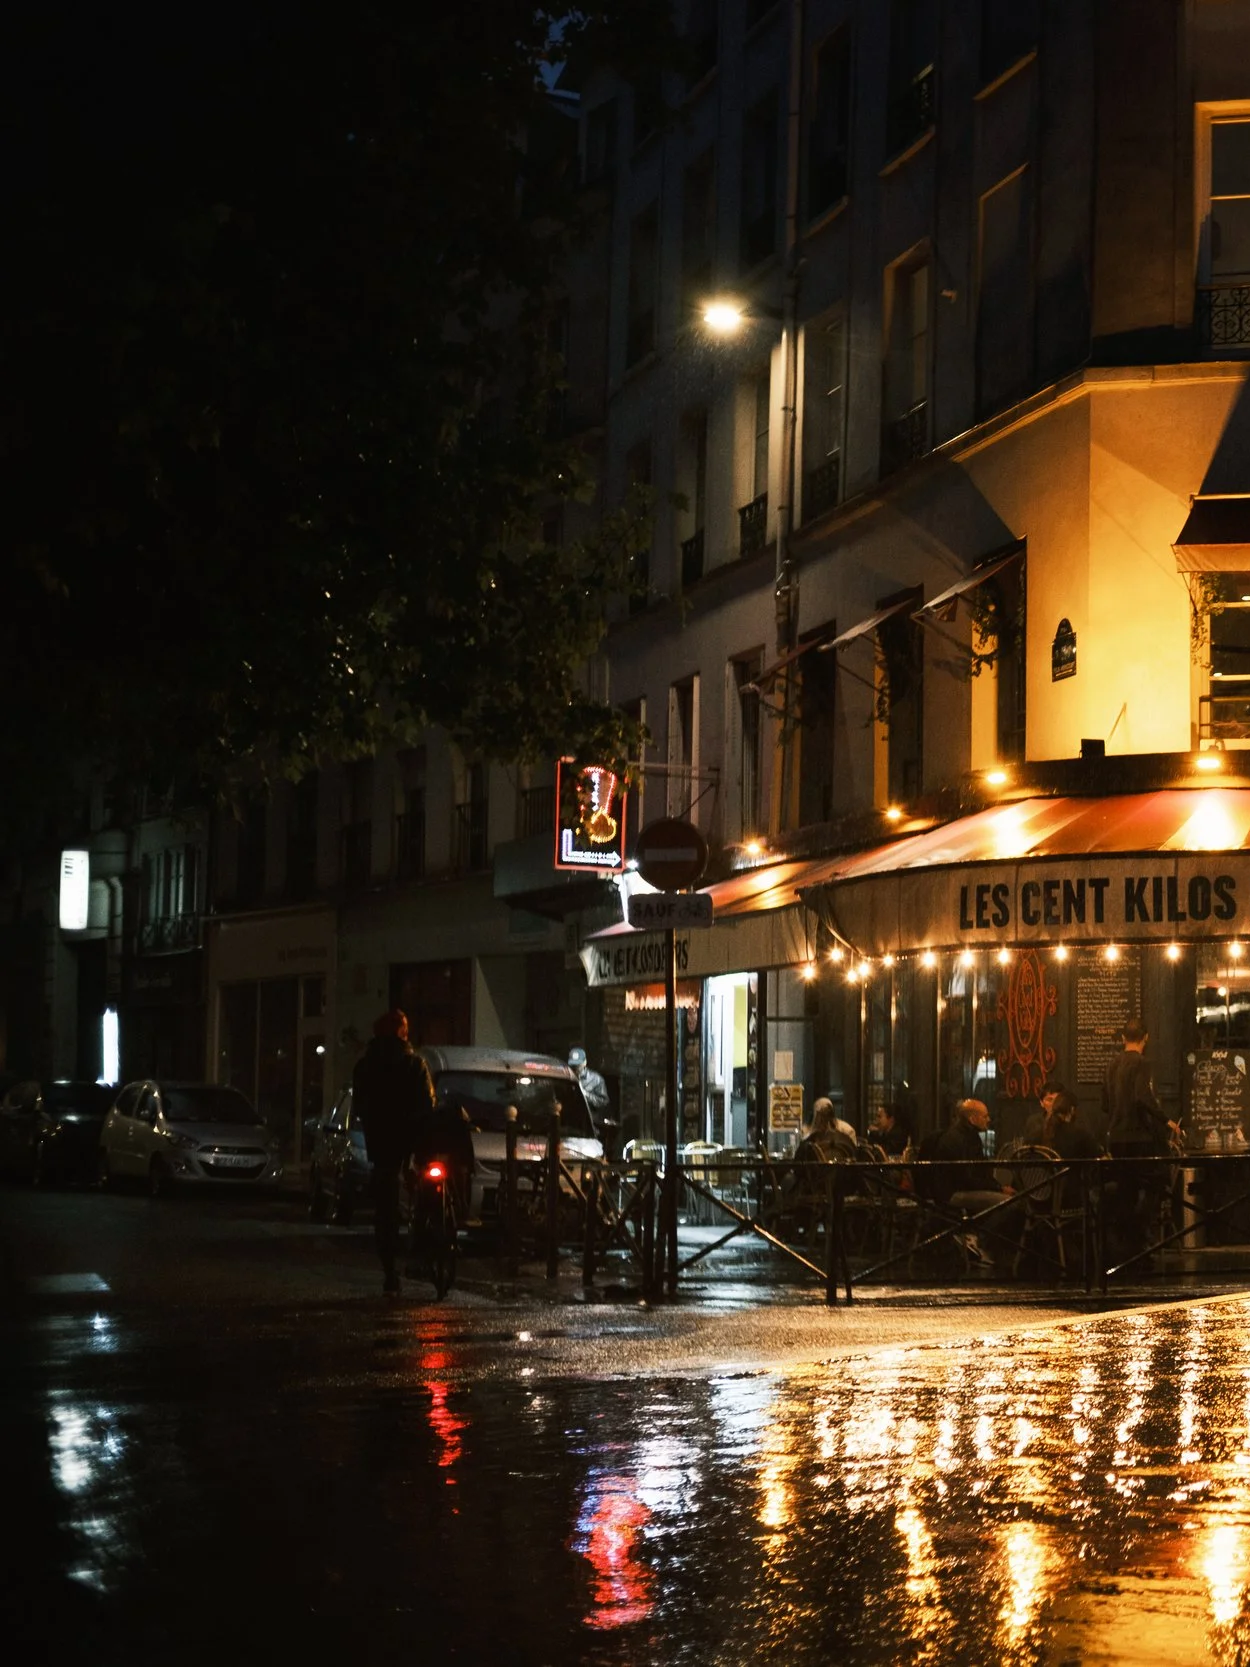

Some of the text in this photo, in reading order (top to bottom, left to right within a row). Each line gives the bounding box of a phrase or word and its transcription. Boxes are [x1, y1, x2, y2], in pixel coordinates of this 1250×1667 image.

[634, 903, 676, 919] SAUF
[960, 883, 1010, 930] LES
[1021, 876, 1109, 925] CENT
[1125, 874, 1237, 922] KILOS
